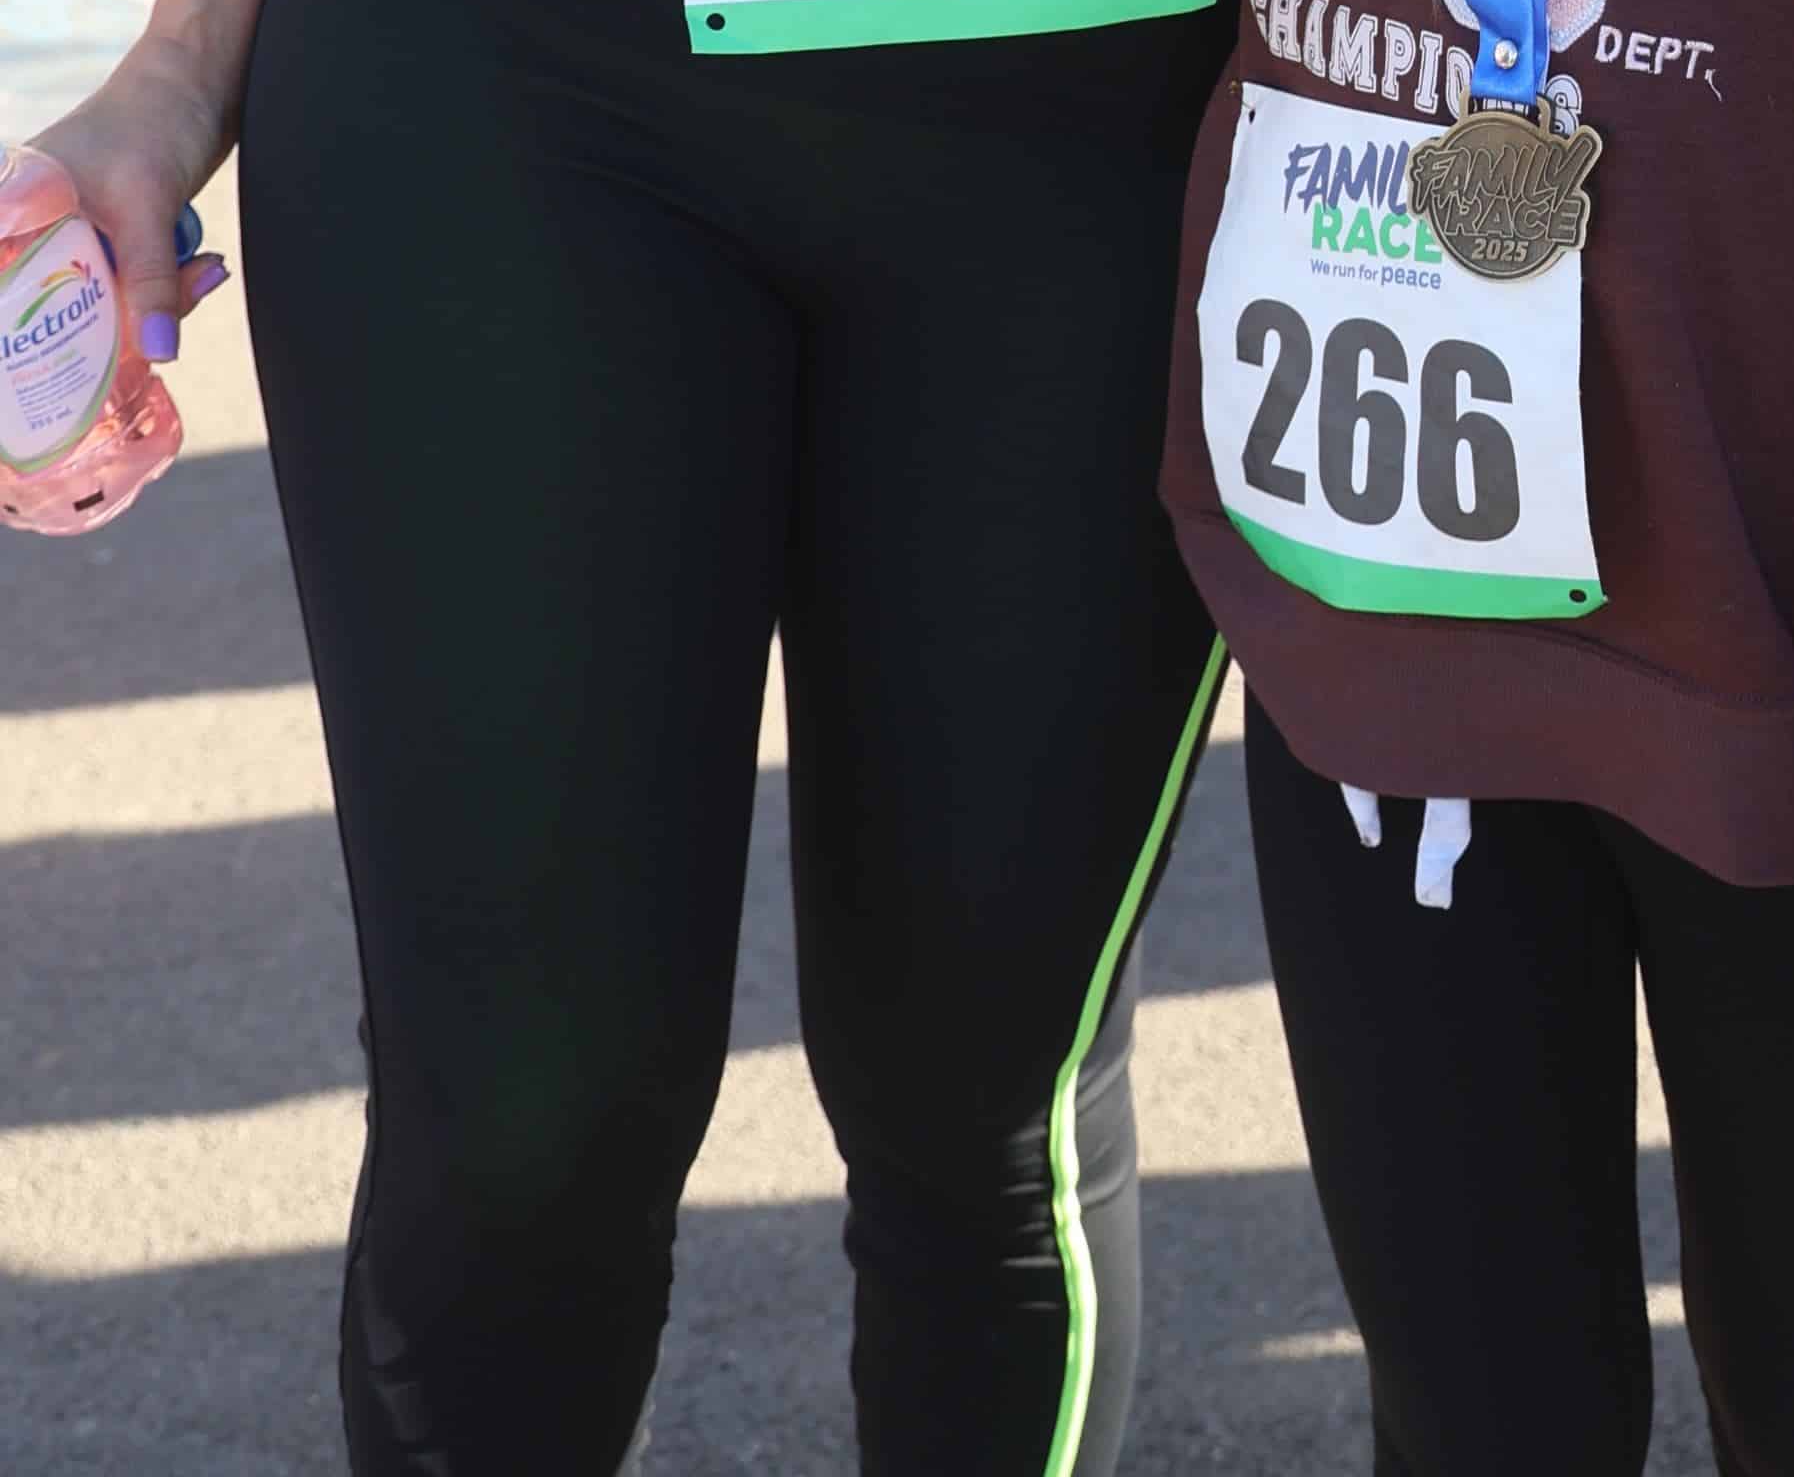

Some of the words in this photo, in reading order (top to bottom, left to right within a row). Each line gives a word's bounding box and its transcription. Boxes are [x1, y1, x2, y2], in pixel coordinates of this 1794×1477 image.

[1284, 140, 1410, 215] FAMIL
[1415, 137, 1593, 212] FAMILY
[1311, 202, 1442, 263] RACE
[1444, 196, 1582, 243] RACE
[1471, 238, 1529, 262] 2025
[1310, 258, 1330, 274] We
[1333, 264, 1356, 278] run
[1359, 263, 1379, 281] for
[1381, 265, 1442, 289] peace
[0, 278, 105, 361] lectrolit
[1235, 298, 1520, 542] 266
